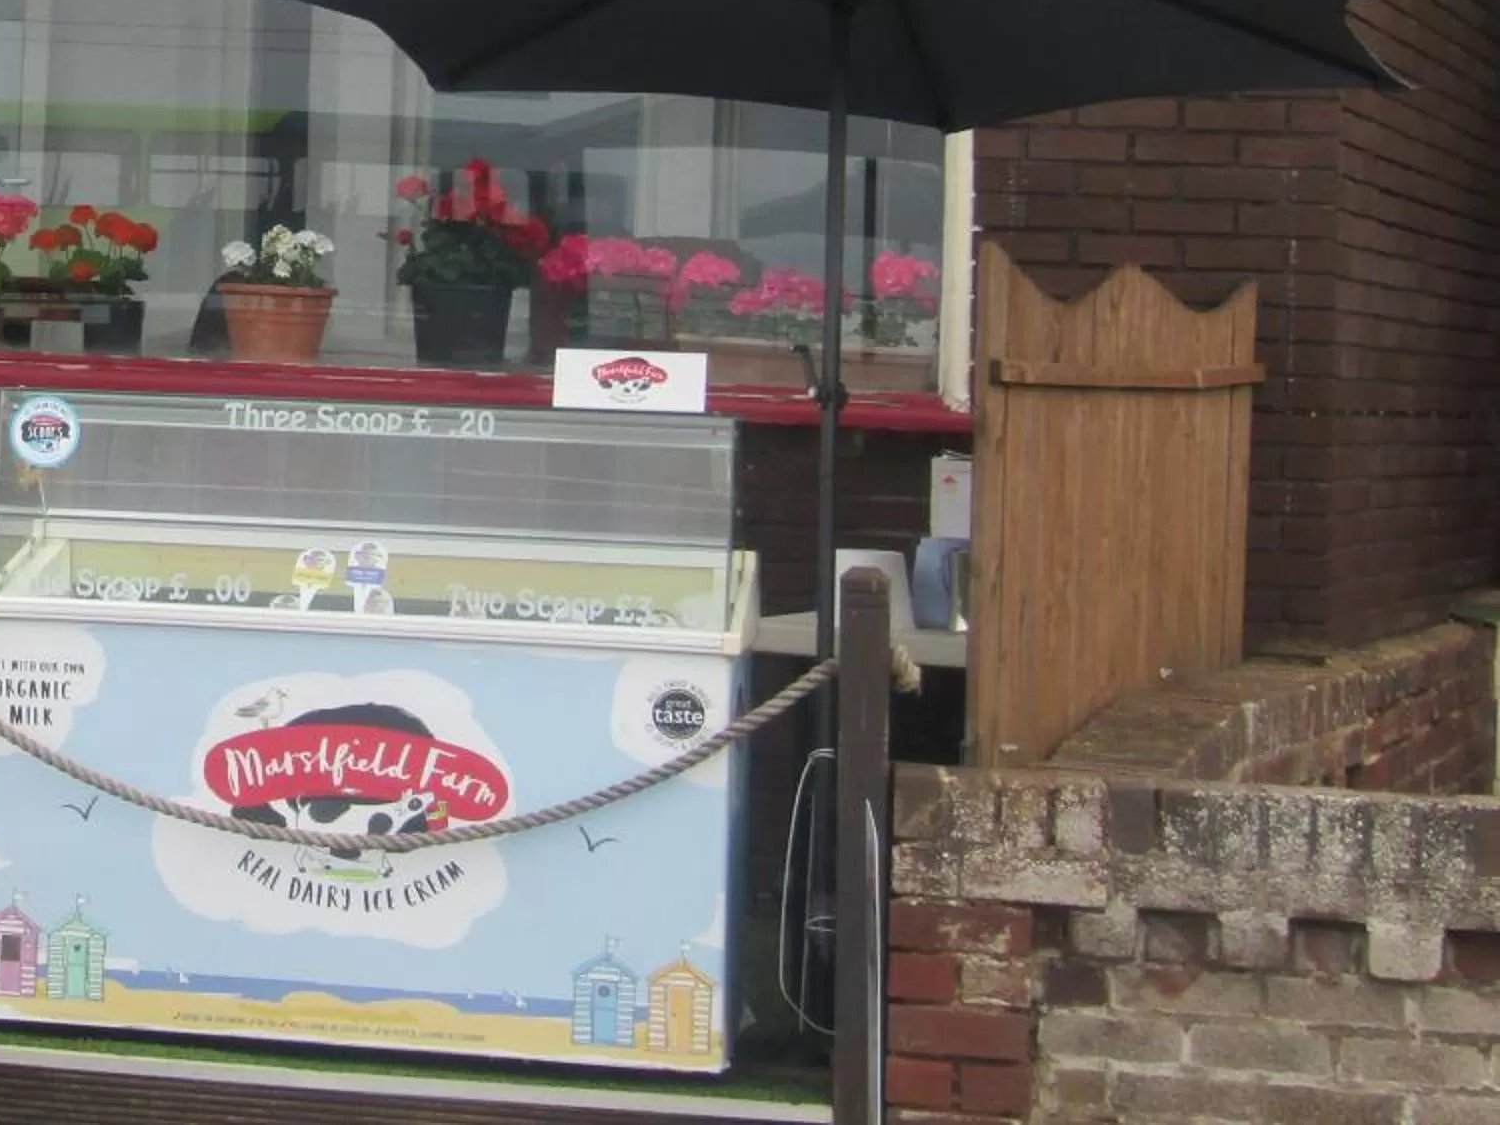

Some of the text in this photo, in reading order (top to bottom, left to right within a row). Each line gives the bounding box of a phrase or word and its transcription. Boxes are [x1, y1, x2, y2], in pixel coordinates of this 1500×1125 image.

[225, 402, 306, 430] Three
[316, 406, 403, 433] Scoop
[75, 569, 161, 602] Scoop
[446, 582, 506, 619] Two
[515, 587, 605, 626] Scoop
[9, 704, 53, 726] MILK
[655, 709, 704, 725] taste
[224, 737, 497, 807] Marshfield Farm
[237, 849, 465, 913] REAL DAIRY ICE CREAM
